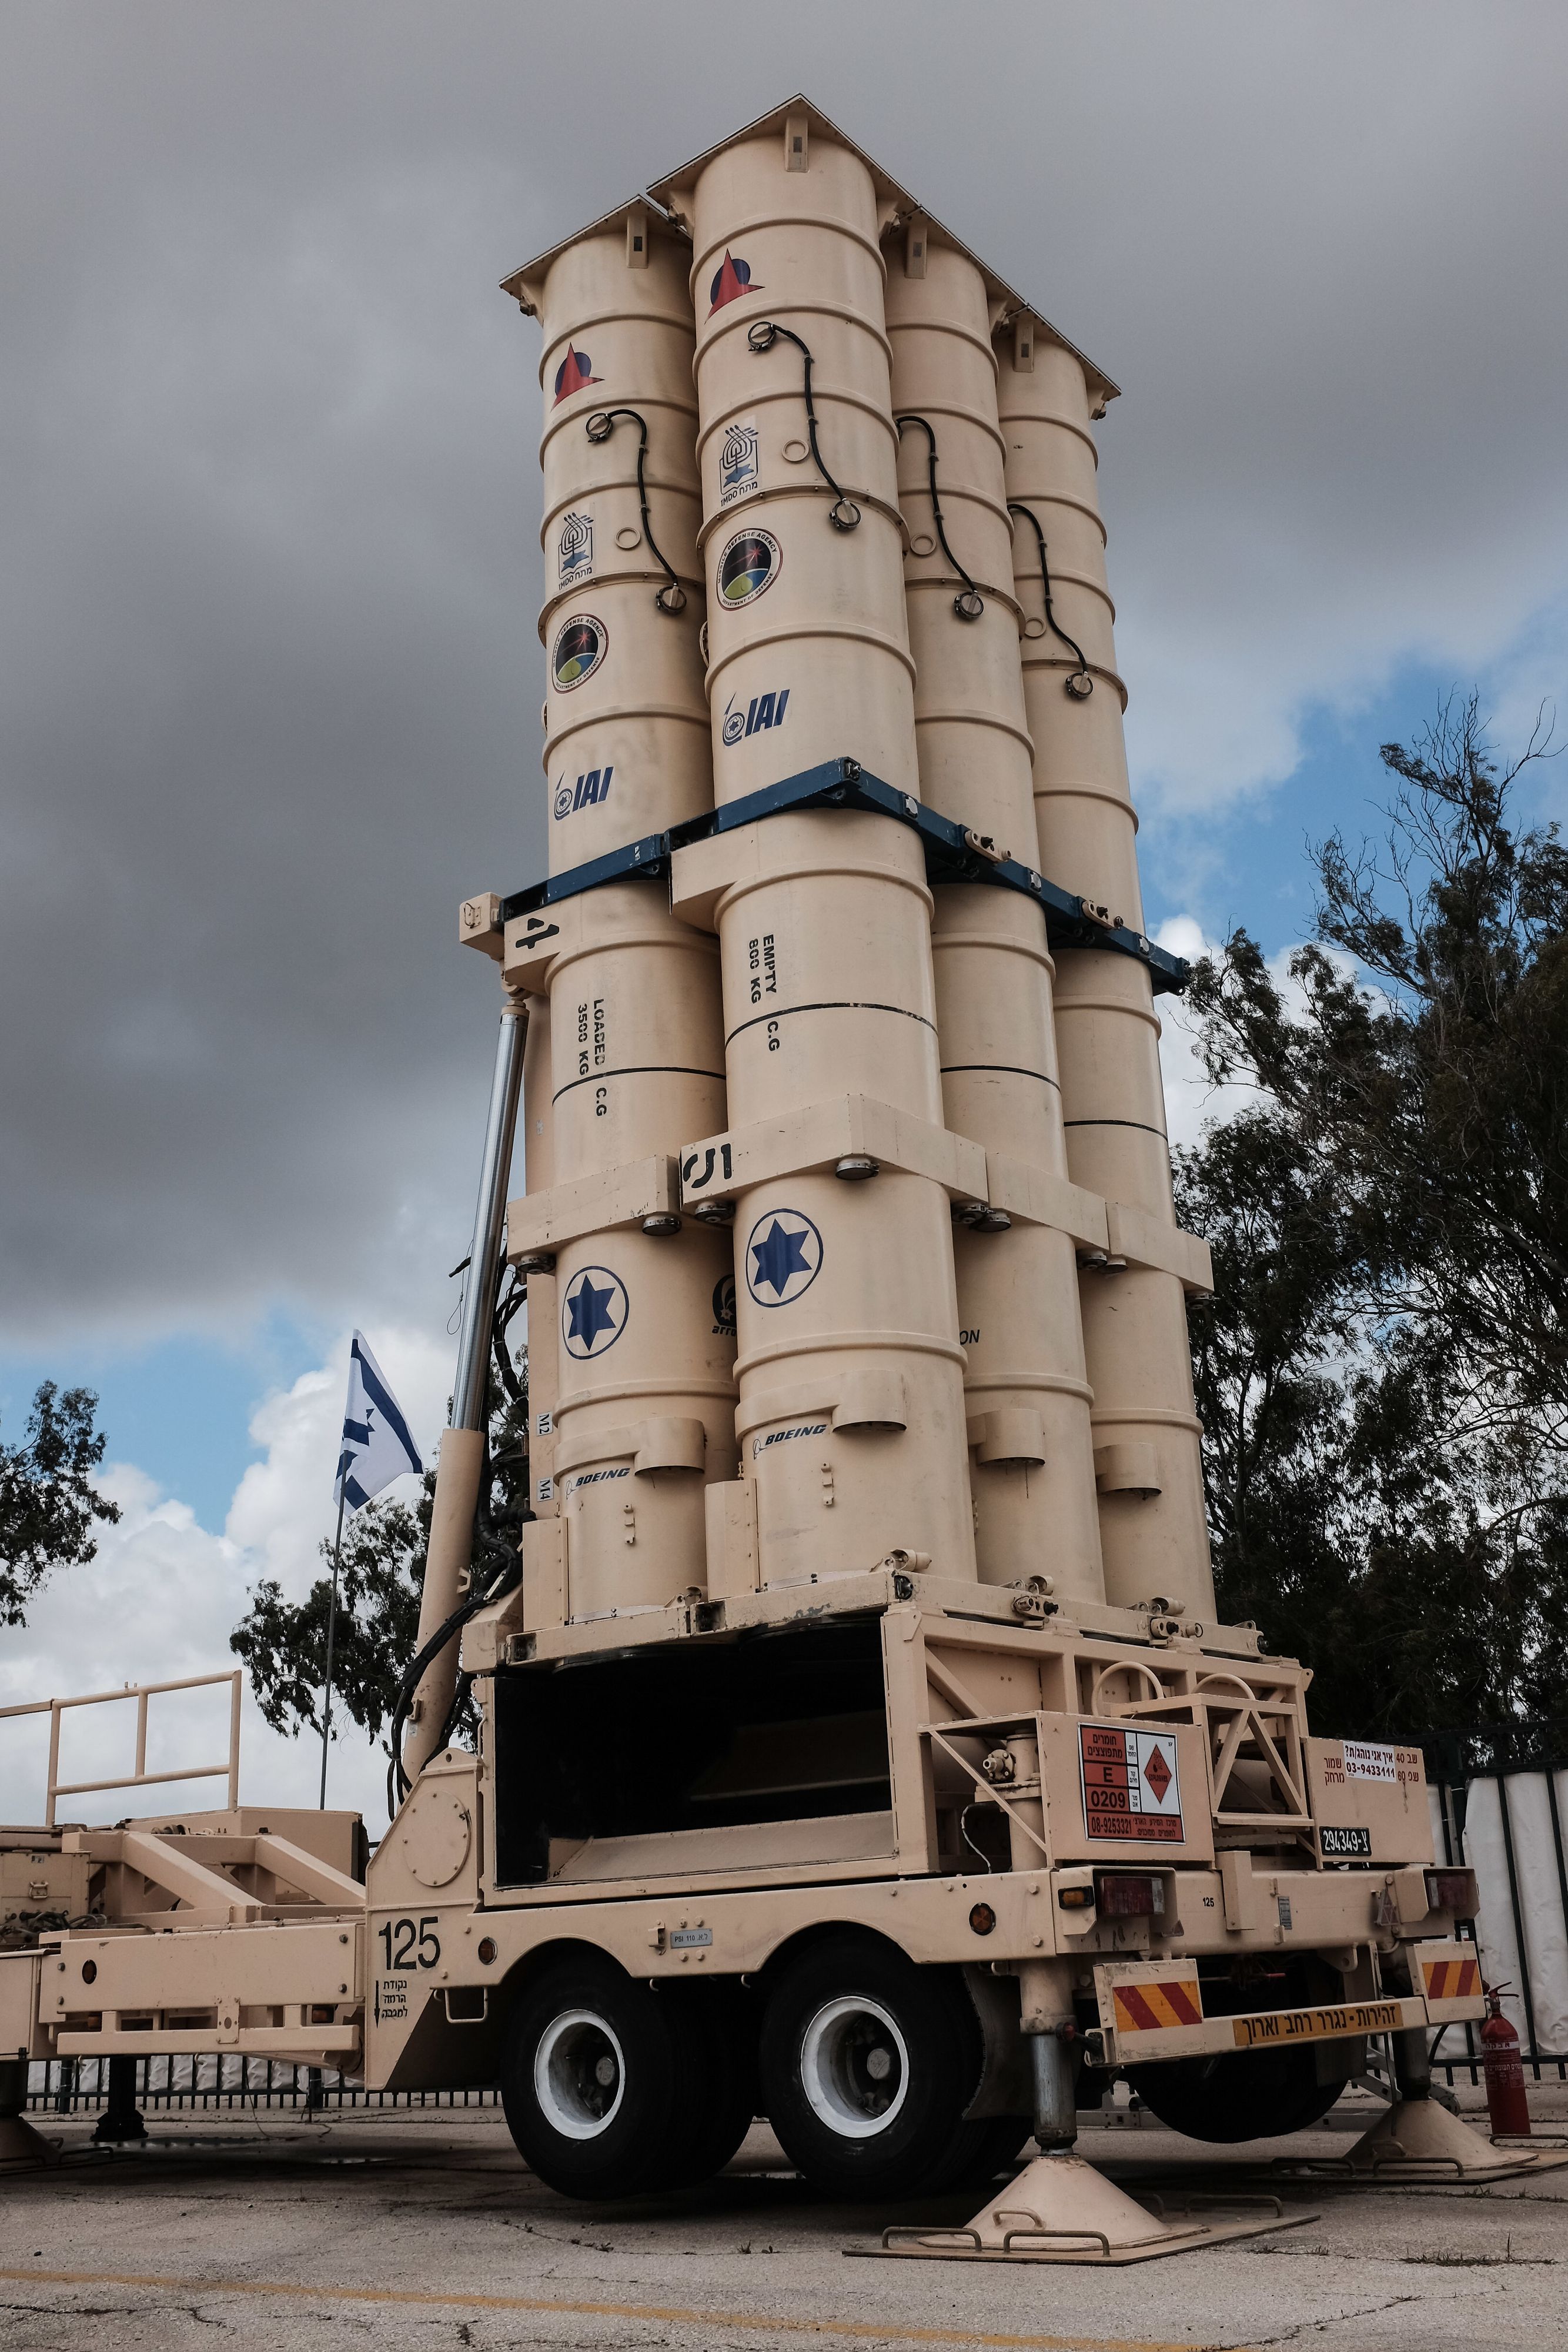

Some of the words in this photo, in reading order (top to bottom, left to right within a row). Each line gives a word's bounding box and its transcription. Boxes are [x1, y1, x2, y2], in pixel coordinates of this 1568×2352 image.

[740, 481, 758, 495] מתח
[721, 490, 737, 506] IMDO
[718, 552, 727, 583] MISSILE
[727, 532, 755, 550] DEFENSE
[756, 533, 777, 553] AGENCY
[575, 567, 592, 580] מתח
[559, 576, 574, 590] IMDO
[755, 573, 773, 594] DEFENSE
[560, 617, 584, 636] DEFENSE
[586, 619, 604, 637] AGENCY
[583, 657, 600, 678] DEFENSE
[745, 689, 790, 737] IAI
[573, 766, 614, 812] IAI
[749, 938, 759, 970] 800
[763, 934, 777, 993] EMPTY
[751, 977, 761, 1004] KG
[578, 1003, 588, 1043] 3500
[594, 998, 605, 1066] LOADED
[767, 1021, 780, 1051] C.G
[579, 1050, 589, 1075] KG
[596, 1087, 607, 1117] C.G
[712, 1325, 737, 1337] arro
[539, 1414, 550, 1434] M2
[765, 1424, 827, 1445] BOEING
[576, 1468, 630, 1486] BOEING
[540, 1479, 551, 1499] M4
[1092, 1734, 1116, 1745] חומרים
[1088, 1746, 1122, 1759] מתפוצצים
[1345, 1745, 1370, 1760] נוהג/ת?
[1372, 1750, 1382, 1762] אני
[1382, 1752, 1393, 1765] איך
[1396, 1753, 1405, 1763] 40
[1407, 1753, 1417, 1764] שב
[1324, 1758, 1342, 1769] שמור
[1346, 1762, 1395, 1778] 03-9433111
[1103, 1767, 1114, 1783] E
[1149, 1774, 1168, 1782] EXPLOSIVES
[1325, 1772, 1345, 1786] מרחק
[1398, 1770, 1406, 1781] 60
[1091, 1790, 1125, 1808] 0209
[1091, 1816, 1132, 1834] 08-9253321
[1202, 1897, 1214, 1907] 125
[379, 1916, 440, 1970] 125
[383, 1980, 407, 1992] נקודת
[383, 1994, 406, 2004] הרמה
[382, 2005, 407, 2019] למגבה
[1317, 2010, 1346, 2030] נגרר
[1356, 2006, 1395, 2027] זהירות
[1242, 2016, 1279, 2045] וארוך
[1284, 2013, 1312, 2034] רחב
